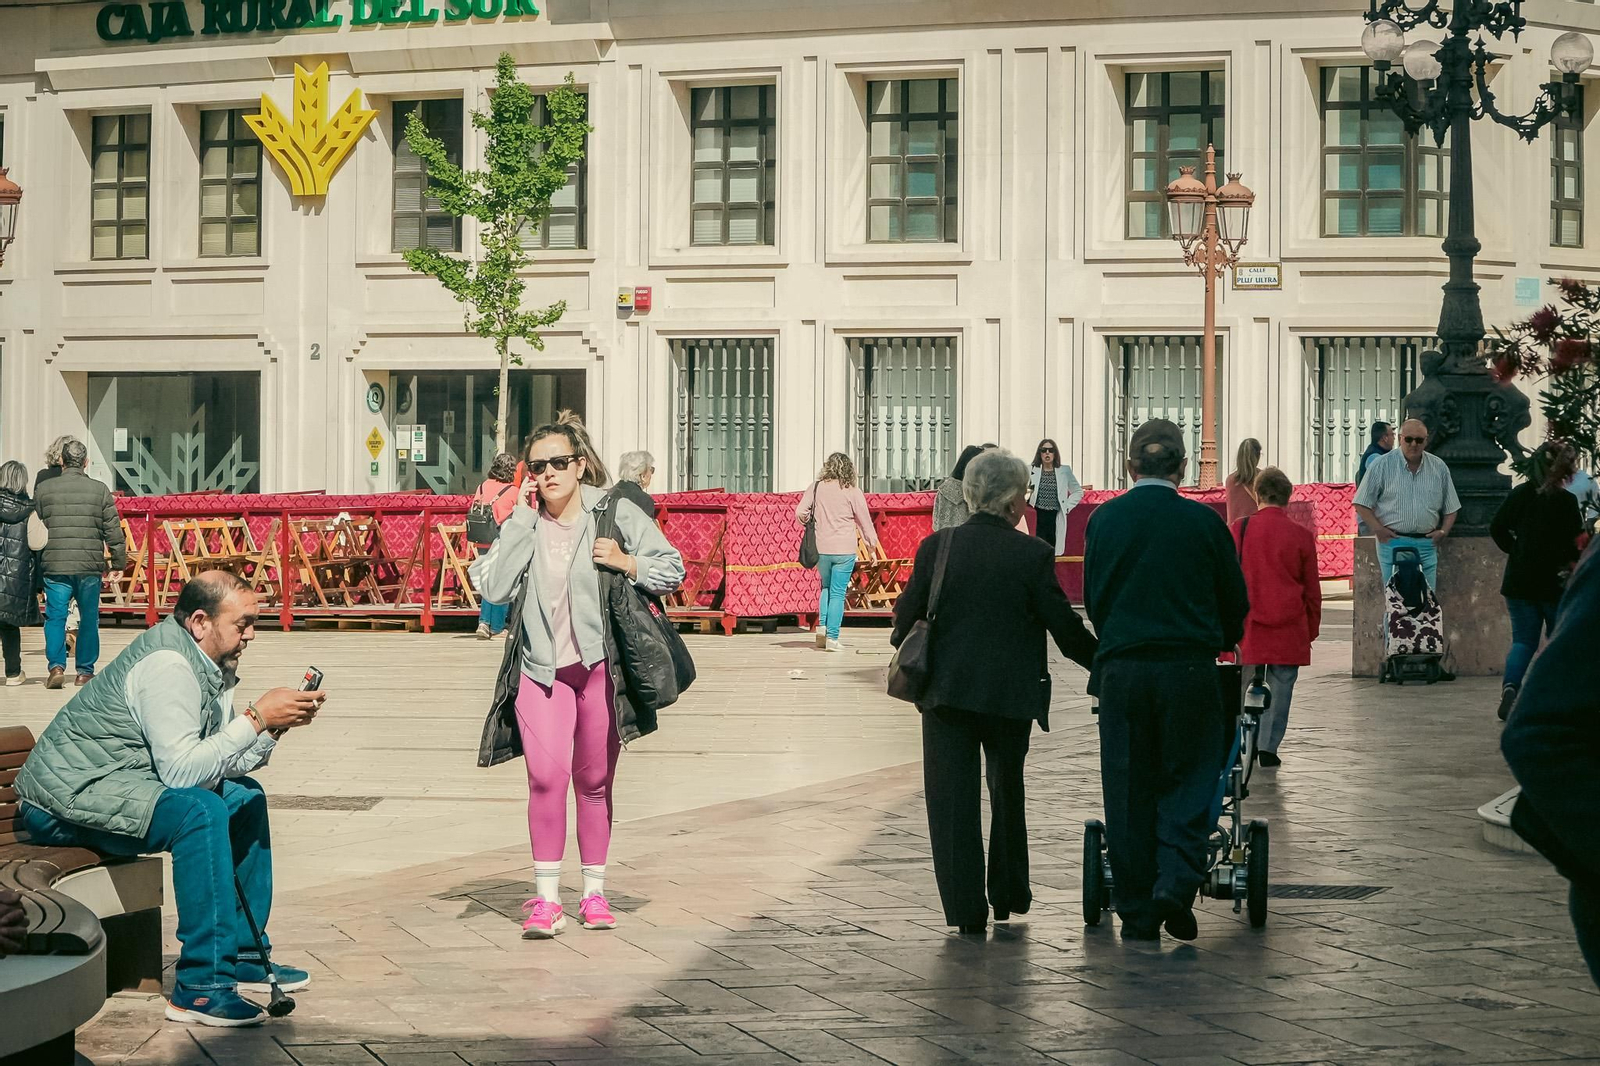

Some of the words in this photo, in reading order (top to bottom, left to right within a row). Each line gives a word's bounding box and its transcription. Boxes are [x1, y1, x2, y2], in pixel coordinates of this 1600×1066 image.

[96, 2, 194, 42] CAJA
[201, 0, 342, 34] RURAL
[350, 0, 439, 25] DEL
[310, 343, 320, 360] 2
